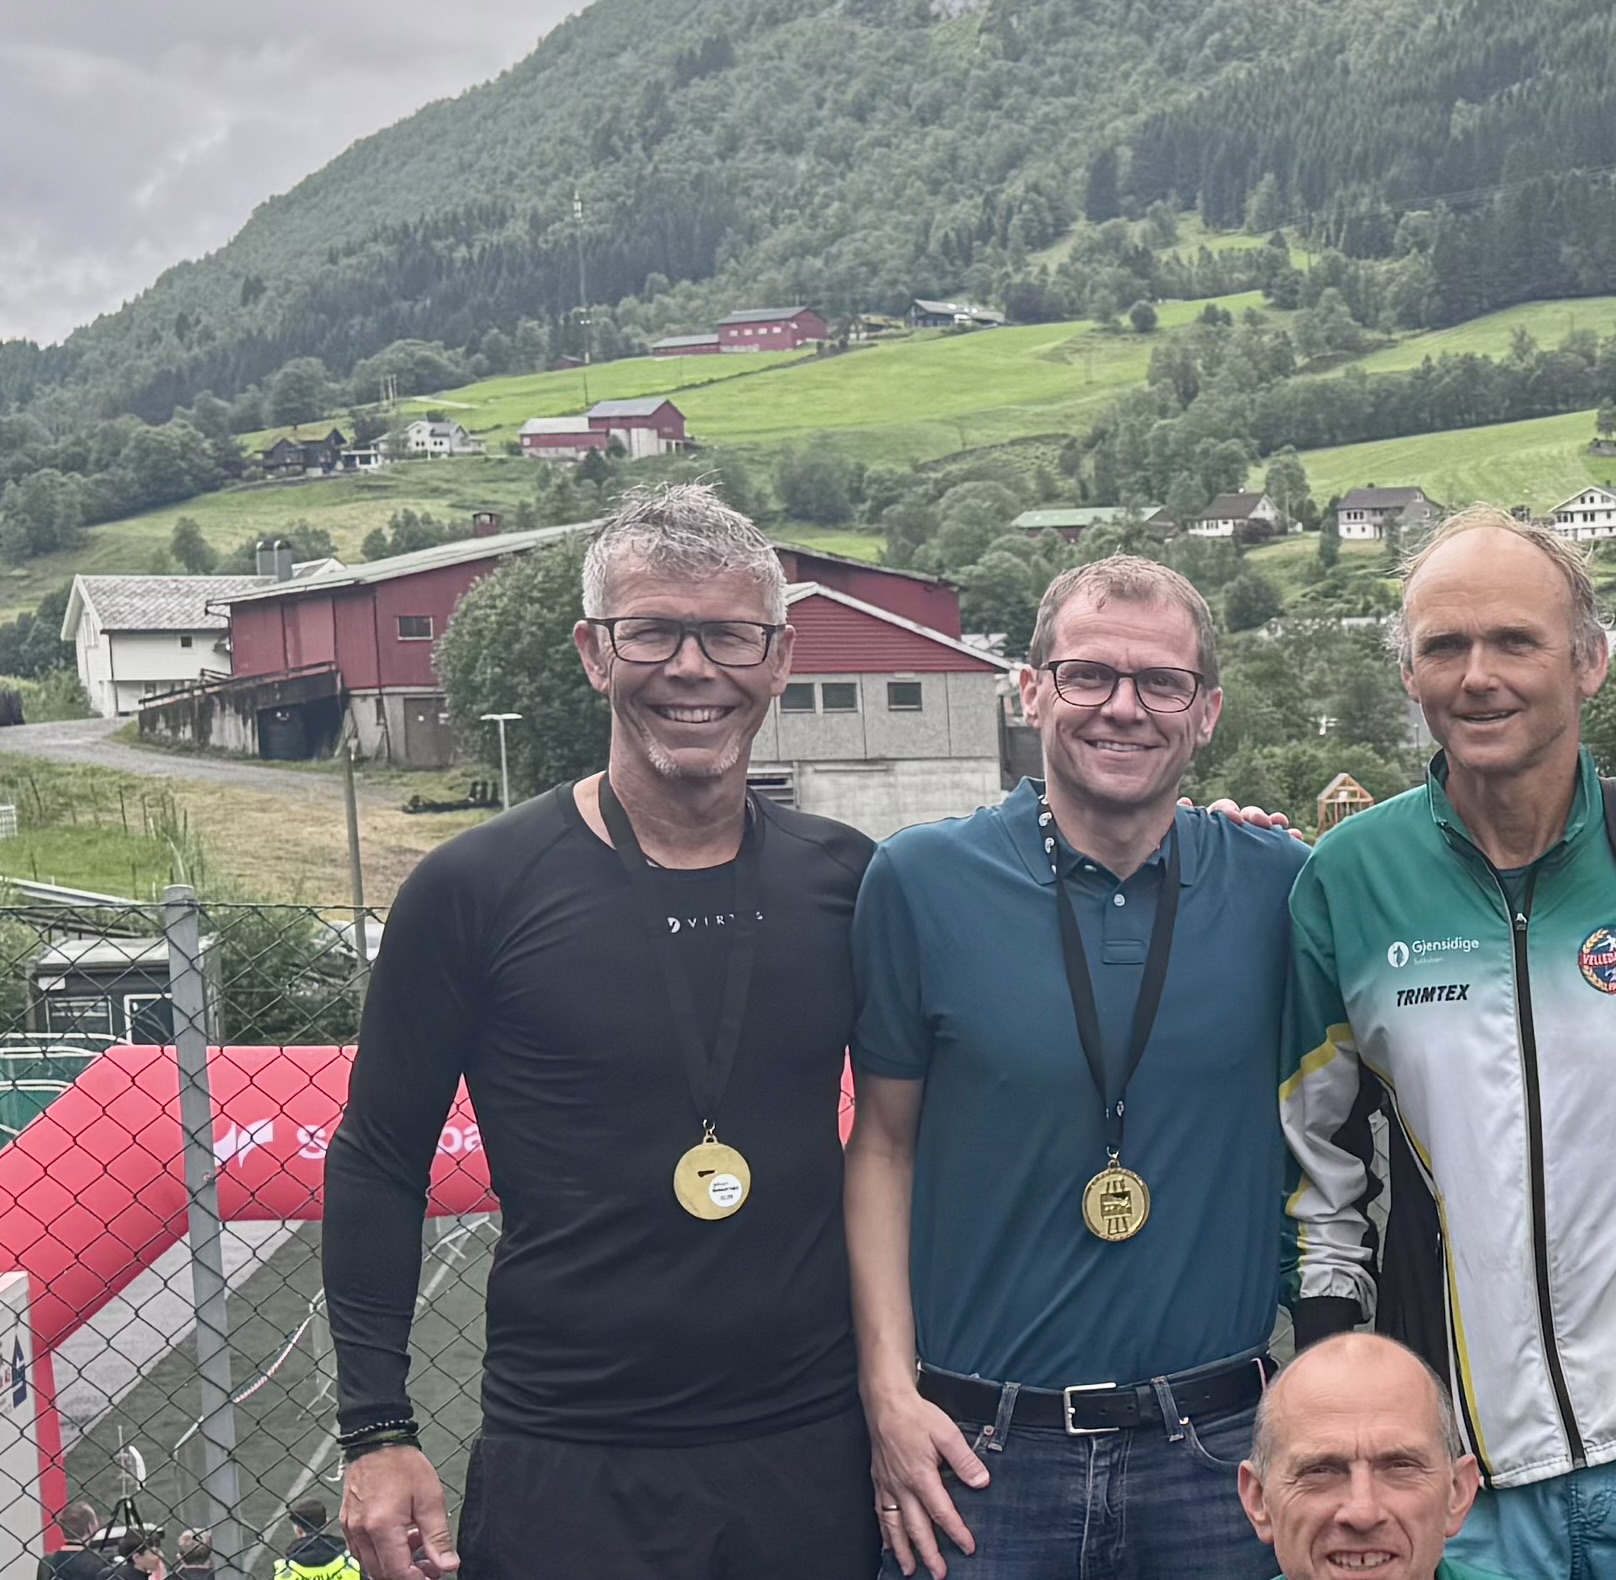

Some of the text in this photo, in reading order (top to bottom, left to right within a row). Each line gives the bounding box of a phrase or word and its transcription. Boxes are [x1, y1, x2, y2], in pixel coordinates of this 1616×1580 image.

[687, 911, 764, 928] VIRS
[1412, 936, 1480, 956] Gjensidige
[1396, 983, 1470, 1007] TRIMTEX
